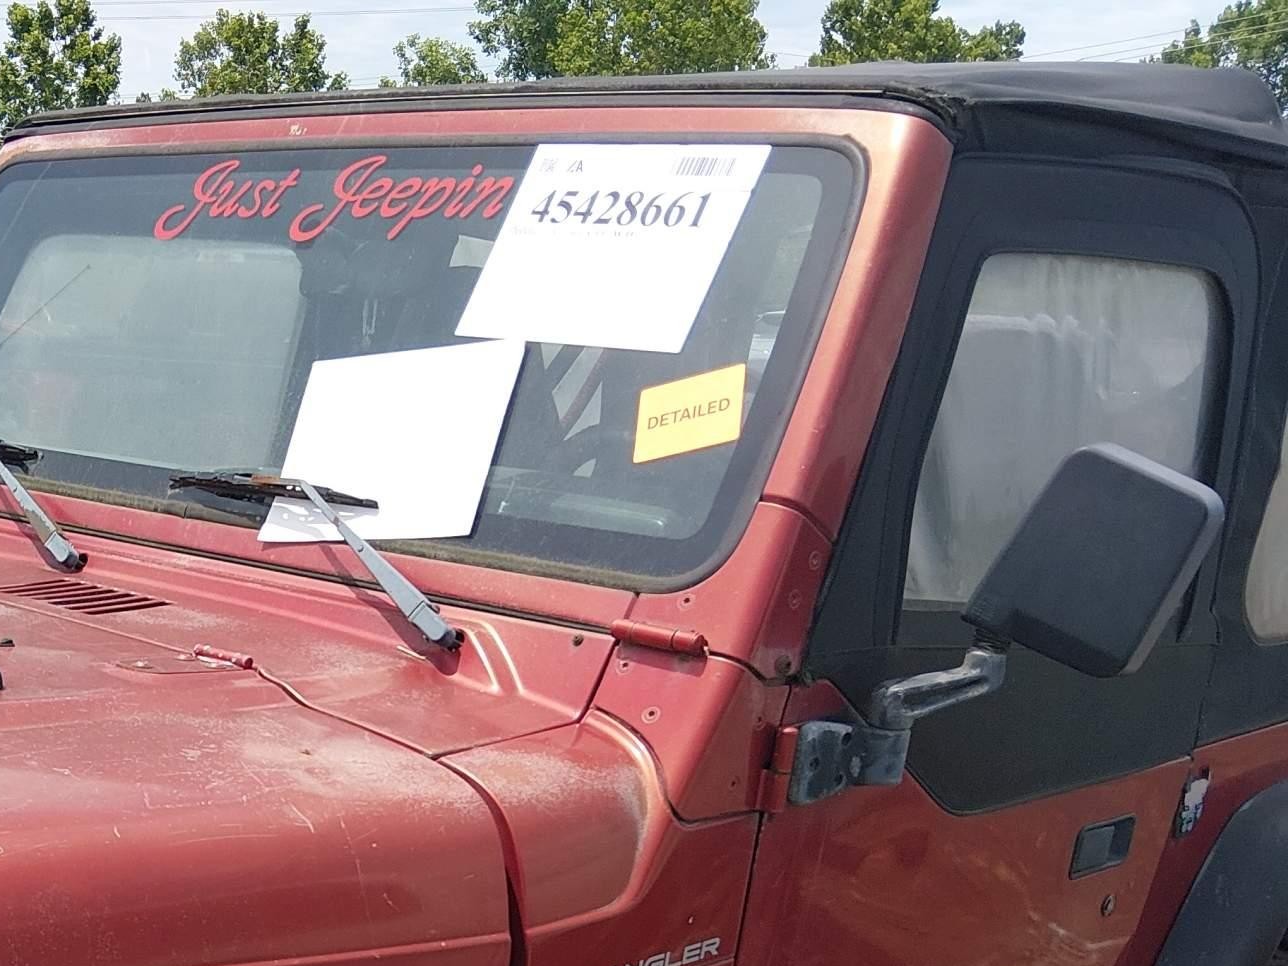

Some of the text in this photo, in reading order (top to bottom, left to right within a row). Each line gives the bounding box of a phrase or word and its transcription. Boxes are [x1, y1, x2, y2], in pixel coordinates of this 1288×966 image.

[153, 155, 515, 243] Just Jeepin
[530, 189, 712, 228] 45428661
[647, 397, 731, 430] DETAILED
